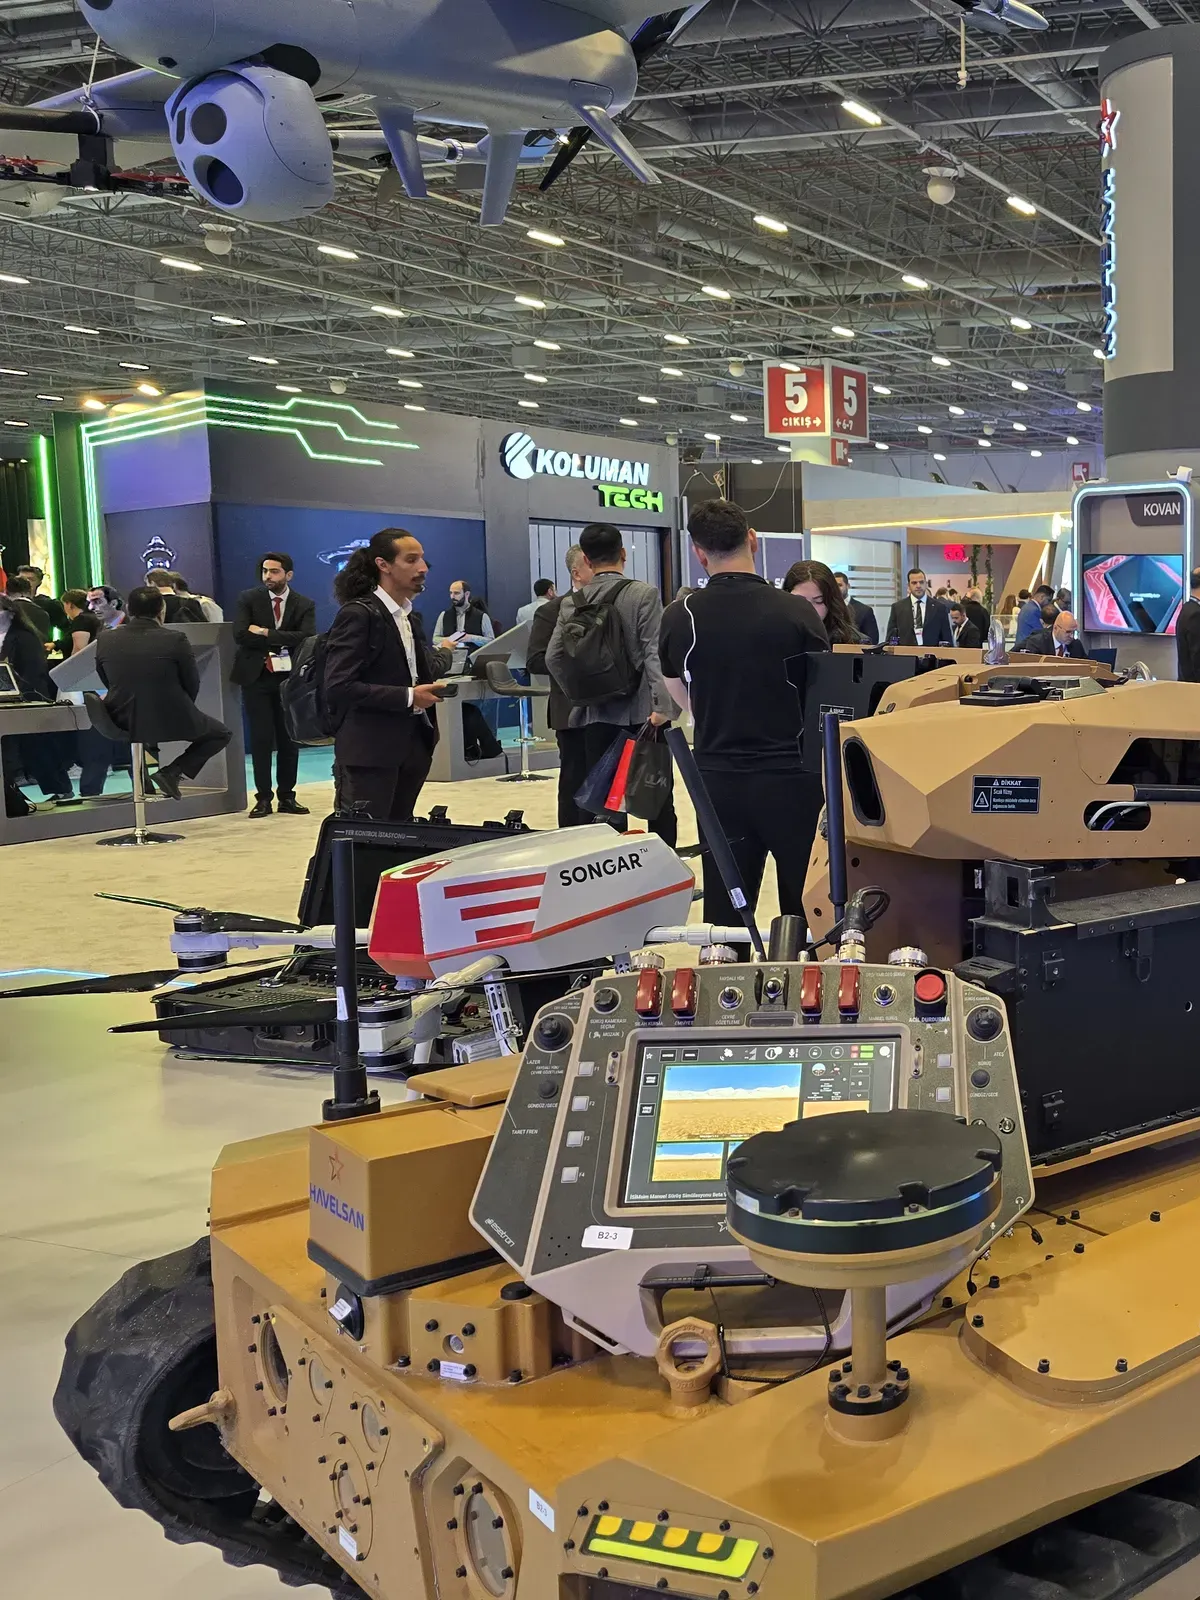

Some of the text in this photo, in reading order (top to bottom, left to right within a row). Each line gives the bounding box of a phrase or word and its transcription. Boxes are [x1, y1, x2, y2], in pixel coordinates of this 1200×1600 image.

[785, 372, 808, 414] 5
[843, 375, 858, 417] 5
[535, 448, 650, 486] KOLUMAN
[597, 484, 664, 513] TECH
[1143, 502, 1181, 517] KOVAN
[559, 853, 642, 887] SONGAR
[308, 1183, 365, 1231] HAVELSAN
[490, 1221, 516, 1248] esetron
[597, 1231, 618, 1240] B2-3
